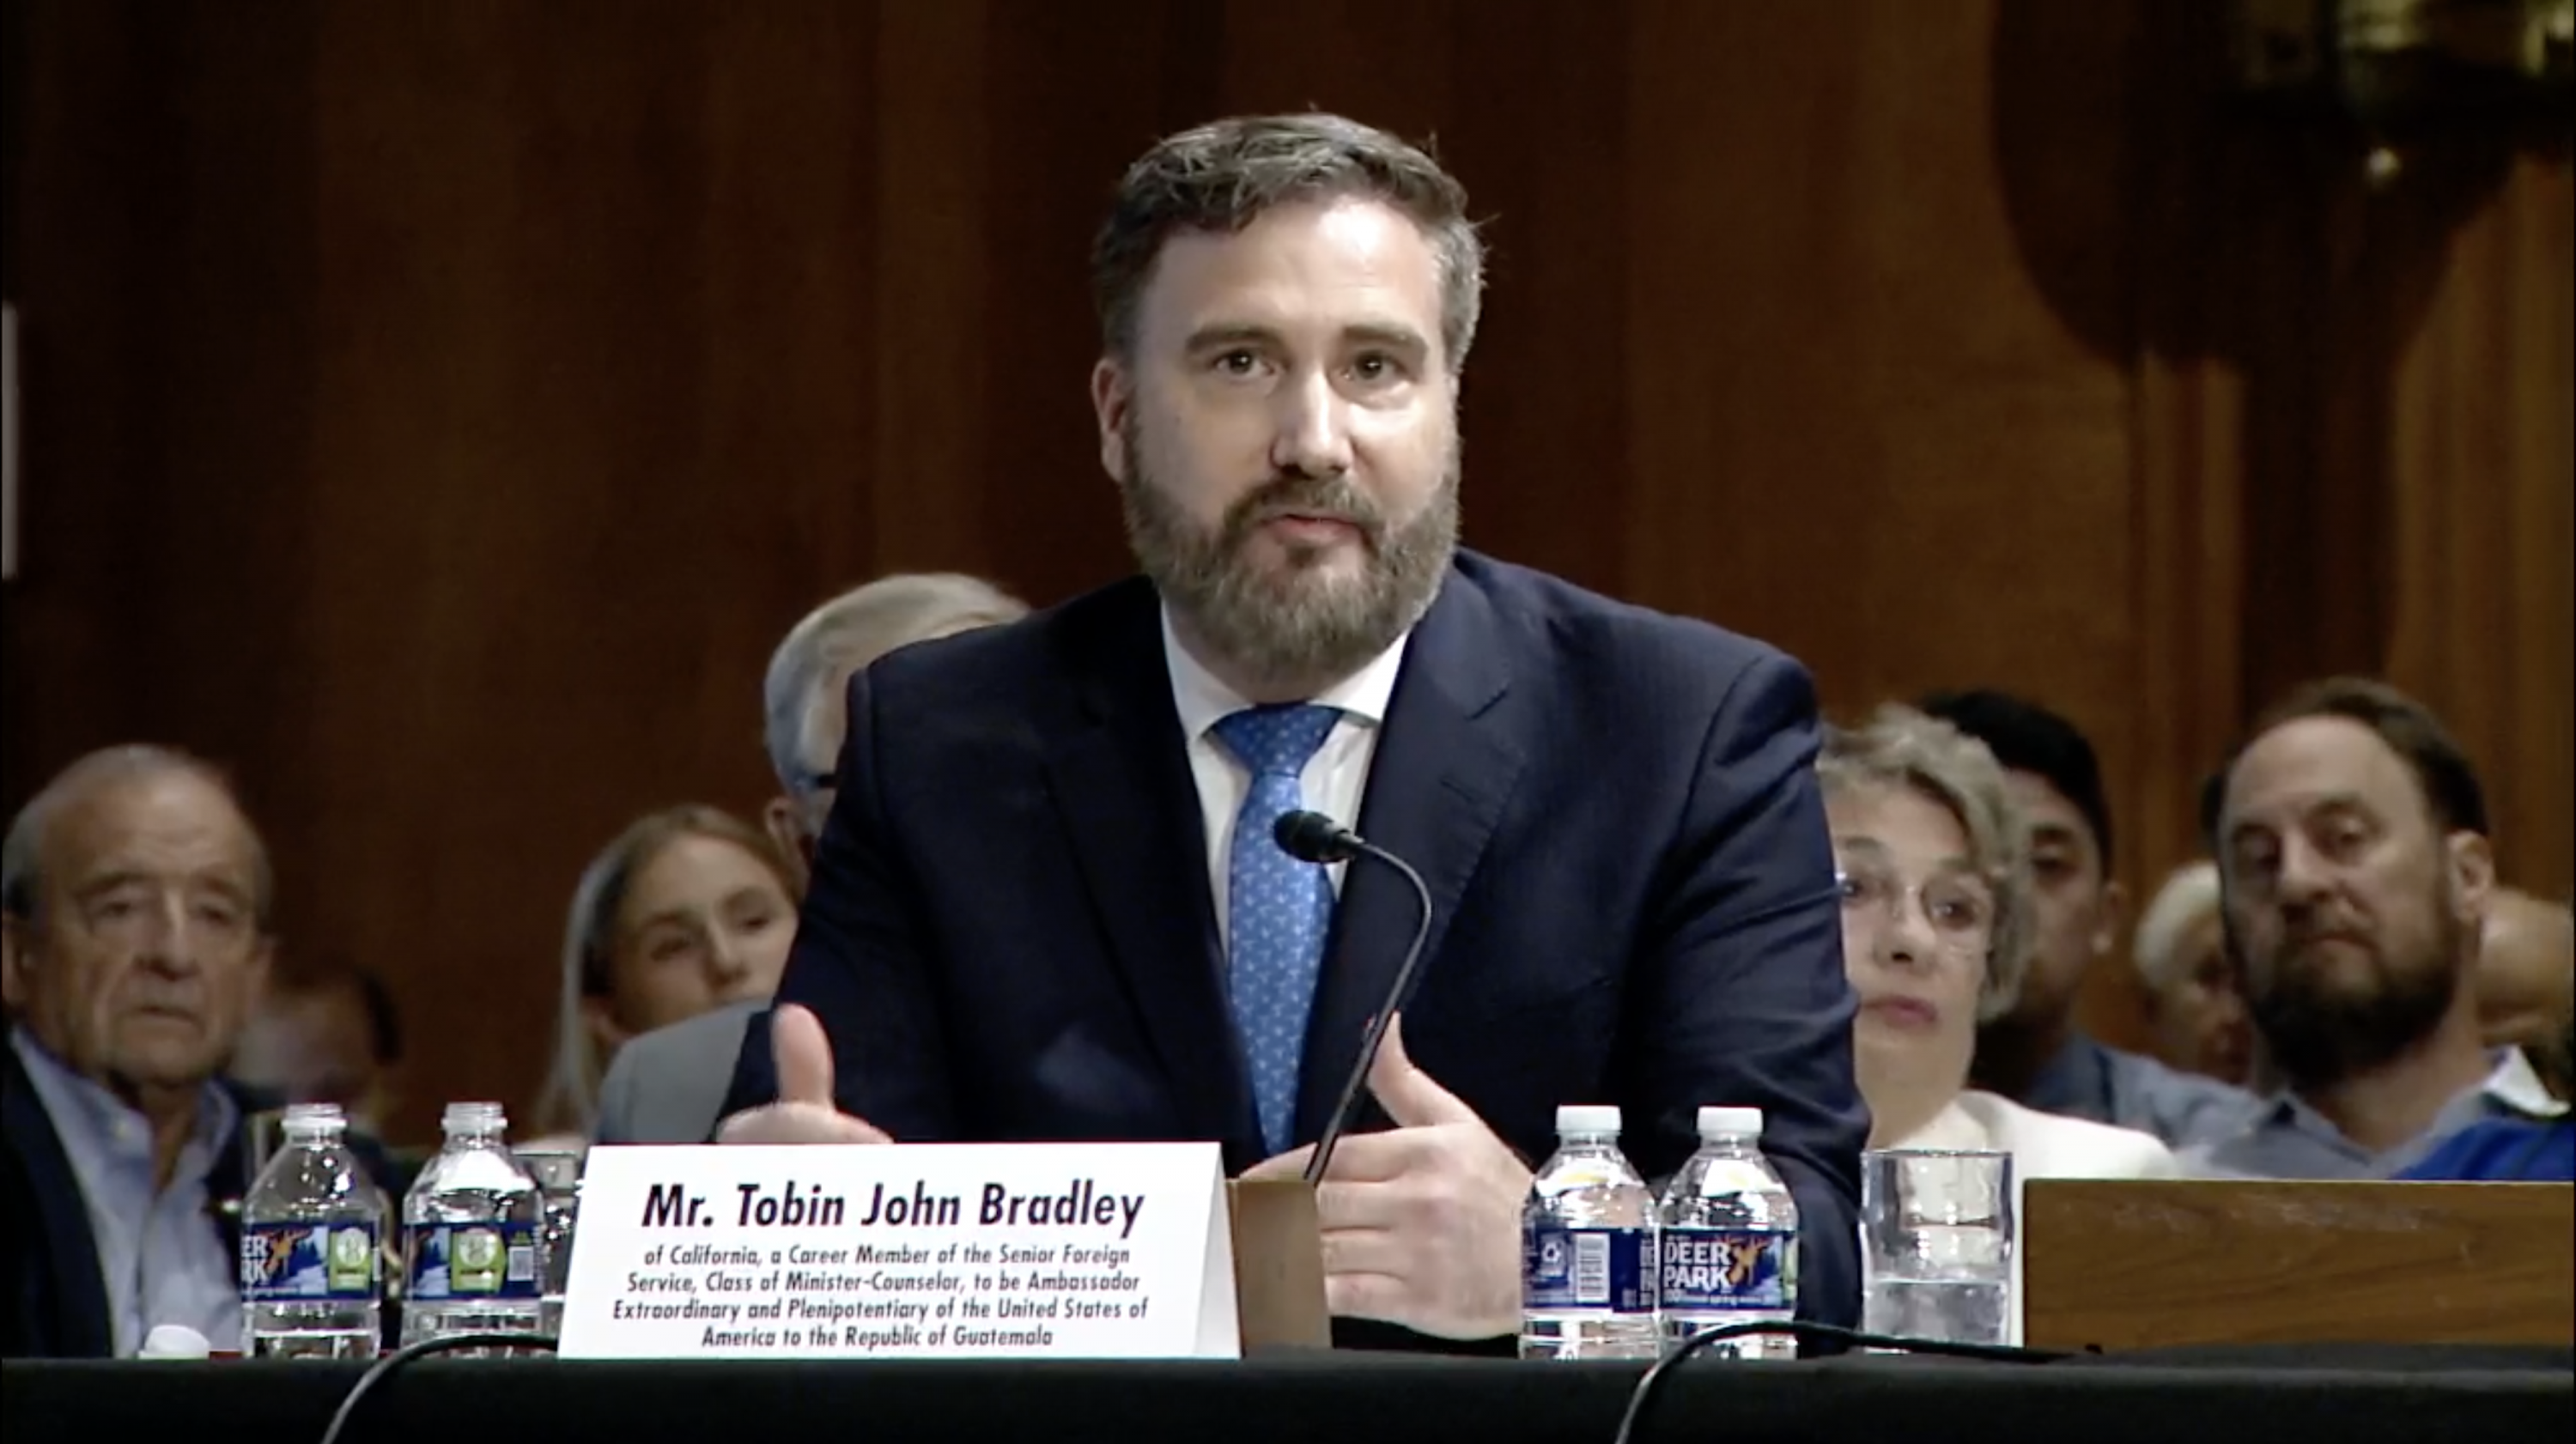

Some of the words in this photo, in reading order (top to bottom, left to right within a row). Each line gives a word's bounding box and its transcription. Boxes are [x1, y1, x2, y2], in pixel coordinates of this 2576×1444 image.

[640, 1183, 714, 1228] Mr.
[735, 1179, 845, 1228] Tobin
[860, 1179, 961, 1227] John
[977, 1178, 1145, 1240] Bradley
[241, 1235, 268, 1257] ER
[643, 1244, 664, 1265] of
[668, 1244, 762, 1266] California,
[769, 1251, 781, 1265] a
[787, 1244, 848, 1265] Career
[854, 1244, 930, 1264] Member
[936, 1244, 957, 1264] of
[963, 1244, 992, 1264] the
[999, 1244, 1054, 1264] Senior
[1061, 1244, 1130, 1269] Foreign
[1664, 1241, 1731, 1261] DEER
[241, 1258, 268, 1283] RK
[627, 1271, 696, 1292] Service,
[704, 1271, 752, 1292] Class
[759, 1271, 780, 1292] of
[784, 1271, 964, 1292] Minister-Counselor,
[973, 1273, 993, 1291] to
[998, 1271, 1021, 1291] be
[1026, 1271, 1139, 1291] Ambassador
[1664, 1264, 1731, 1288] PARK
[612, 1297, 741, 1324] Extraordinary
[746, 1297, 782, 1319] and
[787, 1297, 929, 1324] Plenipotentiary
[934, 1297, 955, 1319] of
[961, 1297, 991, 1319] the
[997, 1297, 1058, 1319] United
[1064, 1297, 1121, 1319] States
[1128, 1297, 1149, 1319] of
[701, 1326, 776, 1347] America
[782, 1329, 802, 1346] to
[808, 1325, 838, 1347] the
[843, 1325, 920, 1351] Republic
[927, 1325, 947, 1346] of
[952, 1325, 1053, 1346] Guatemala
